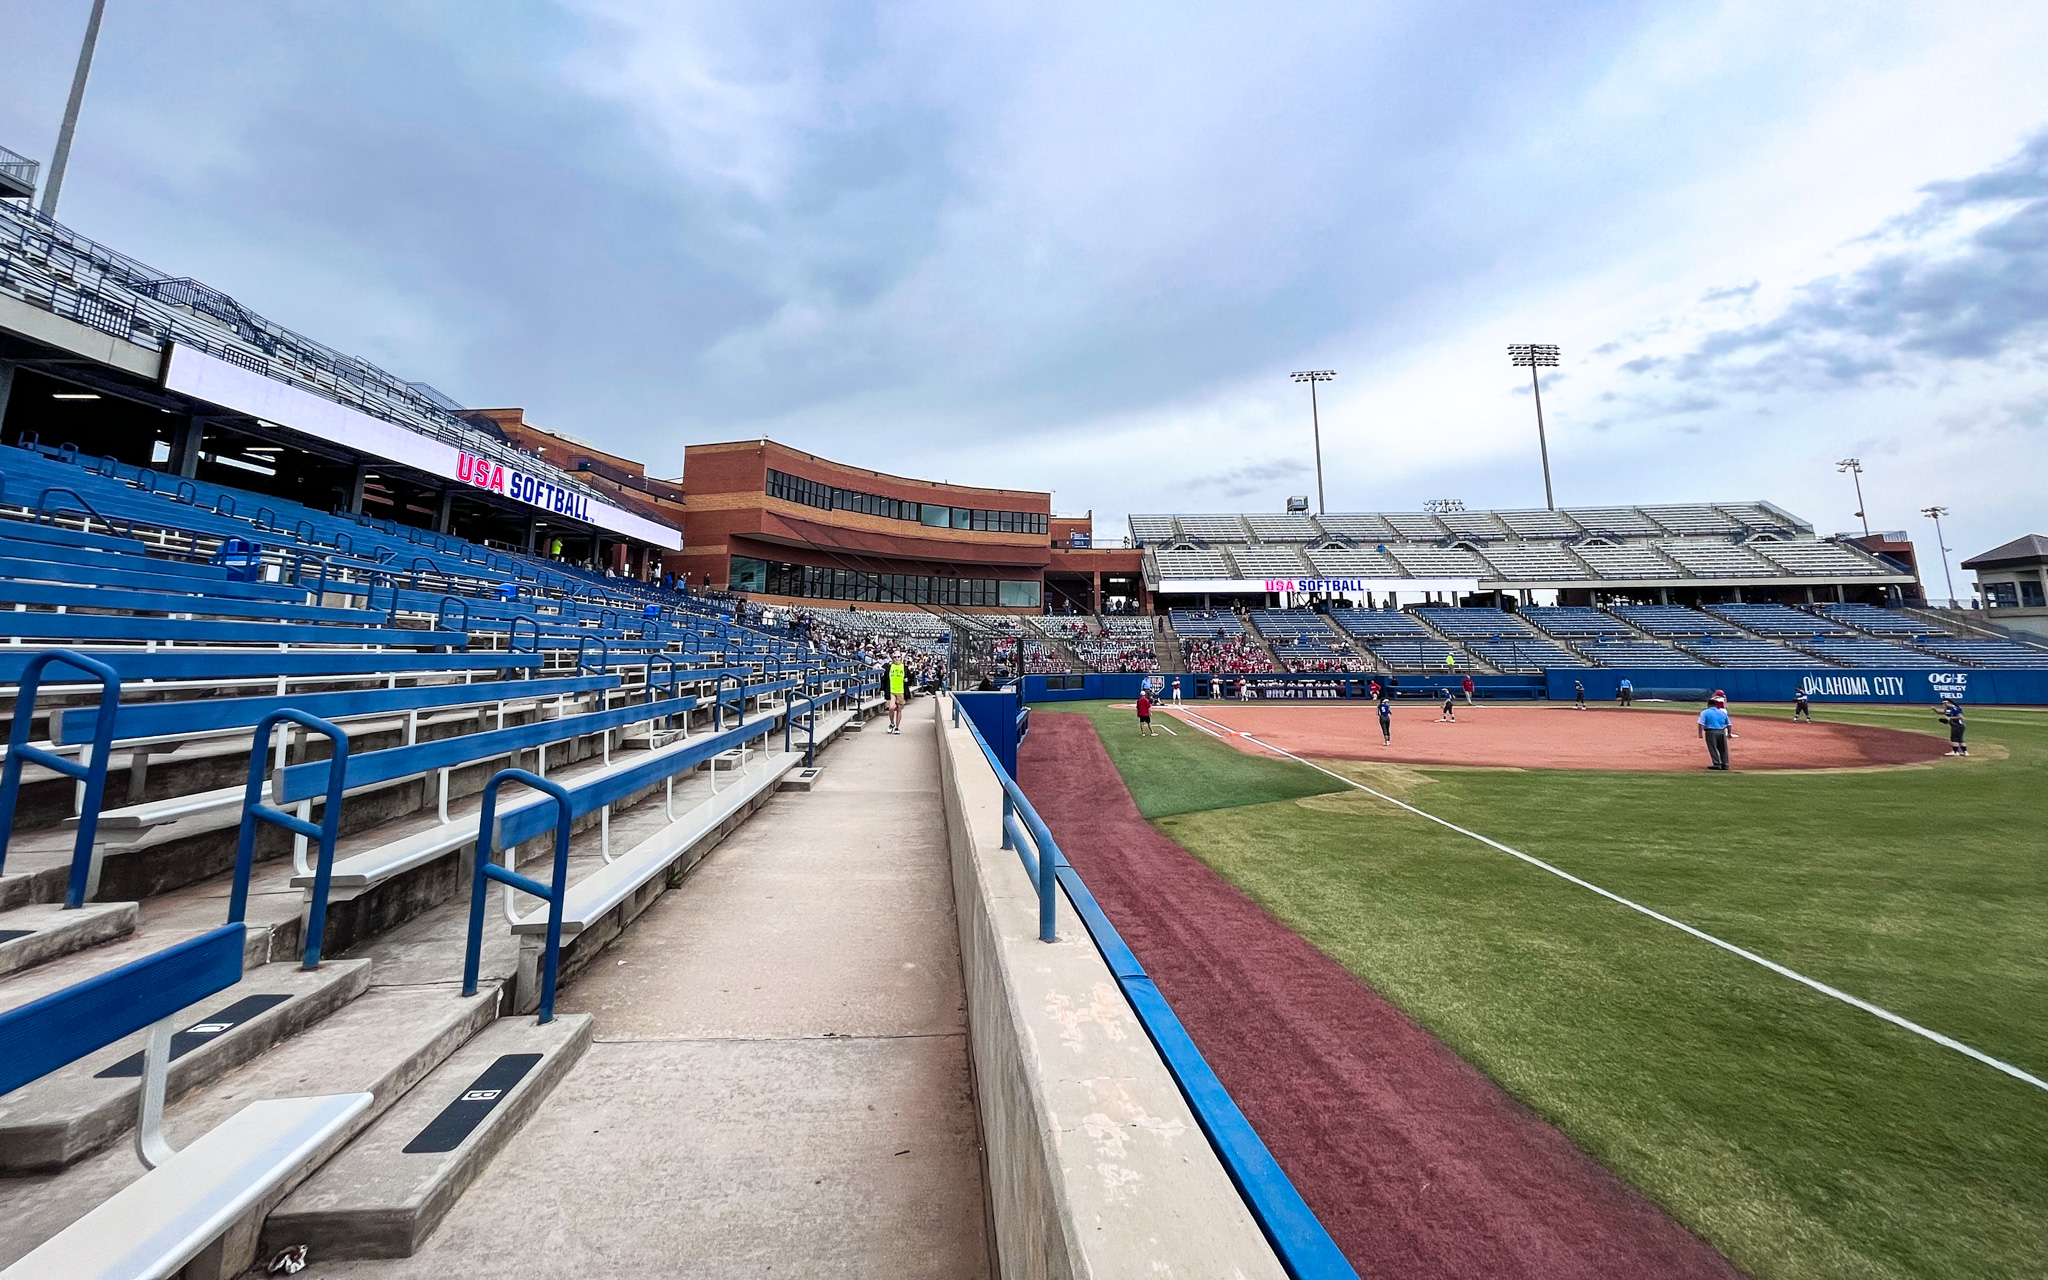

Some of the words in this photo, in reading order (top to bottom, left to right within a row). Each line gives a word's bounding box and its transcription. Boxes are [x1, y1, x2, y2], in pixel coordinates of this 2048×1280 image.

[457, 451, 504, 494] USA
[510, 471, 589, 522] SOFTBALL
[1265, 580, 1295, 592] USA
[1298, 580, 1364, 592] SOFTBALL
[1802, 673, 1872, 696] OKLAHOMA
[1873, 676, 1904, 696] CITY
[1933, 684, 1967, 692] ENERGY
[467, 1091, 498, 1099] B
